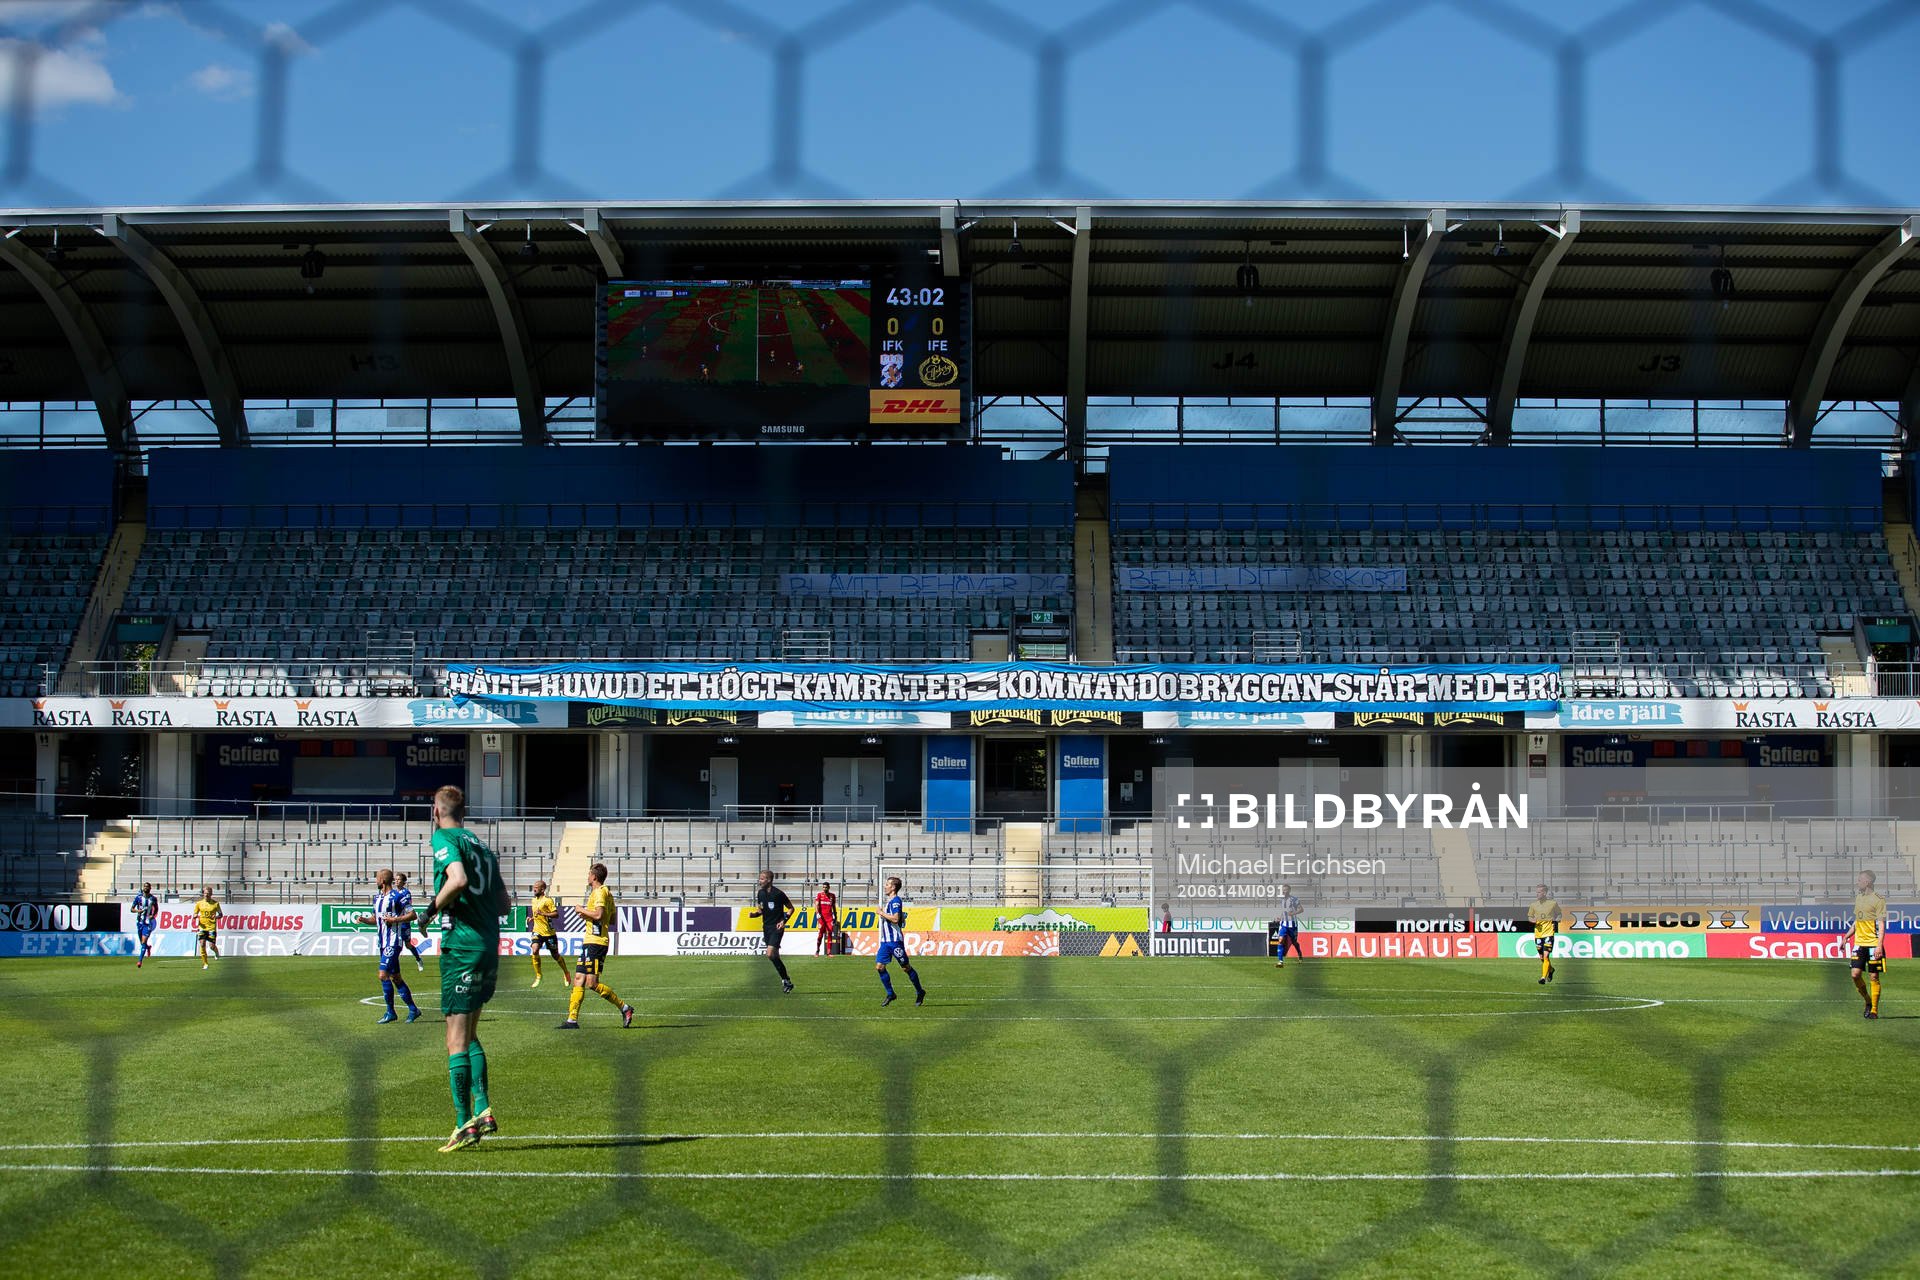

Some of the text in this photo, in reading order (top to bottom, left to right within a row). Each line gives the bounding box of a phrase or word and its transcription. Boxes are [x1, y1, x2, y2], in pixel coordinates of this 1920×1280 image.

[886, 287, 944, 306] 43:02
[887, 317, 944, 336] 0 0
[882, 340, 949, 351] IFK IFE
[1213, 351, 1259, 370] J4
[1639, 354, 1681, 372] J3
[880, 399, 951, 414] DHL
[761, 425, 805, 434] SAMSUNG
[1239, 568, 1292, 586] DITT
[448, 667, 529, 697] HÅLL
[539, 671, 690, 701] HUVUDET
[698, 667, 782, 701] HÖGT
[793, 671, 968, 702] KAMRATER
[996, 670, 1323, 702] KOMMANDOBRYGGAN
[1333, 668, 1417, 702] STÅR
[1427, 673, 1496, 702] MED
[1505, 672, 1561, 702] ER!
[33, 710, 93, 727] RASTA
[111, 710, 172, 727] RASTA
[216, 710, 278, 727] RASTA
[297, 710, 359, 727] RASTA
[424, 703, 521, 722] Idre Fjäll
[587, 705, 656, 726] KOPPARBERG
[1571, 704, 1667, 723] Idre Fjäll
[1736, 712, 1797, 728] RASTA
[1816, 712, 1877, 728] RASTA
[219, 745, 280, 766] Sofiero
[1063, 755, 1100, 768] Sofiero
[1759, 745, 1820, 767] Sofiero
[1396, 913, 1517, 933] morris law.
[1619, 911, 1701, 928] HECO
[1767, 911, 1854, 931] Weblink
[677, 932, 767, 950] Göteborgs
[903, 933, 1005, 957] Renova
[1312, 936, 1474, 957] BAUHAUS
[1551, 935, 1690, 958] Rekomo
[1749, 935, 1851, 958] Scandi
